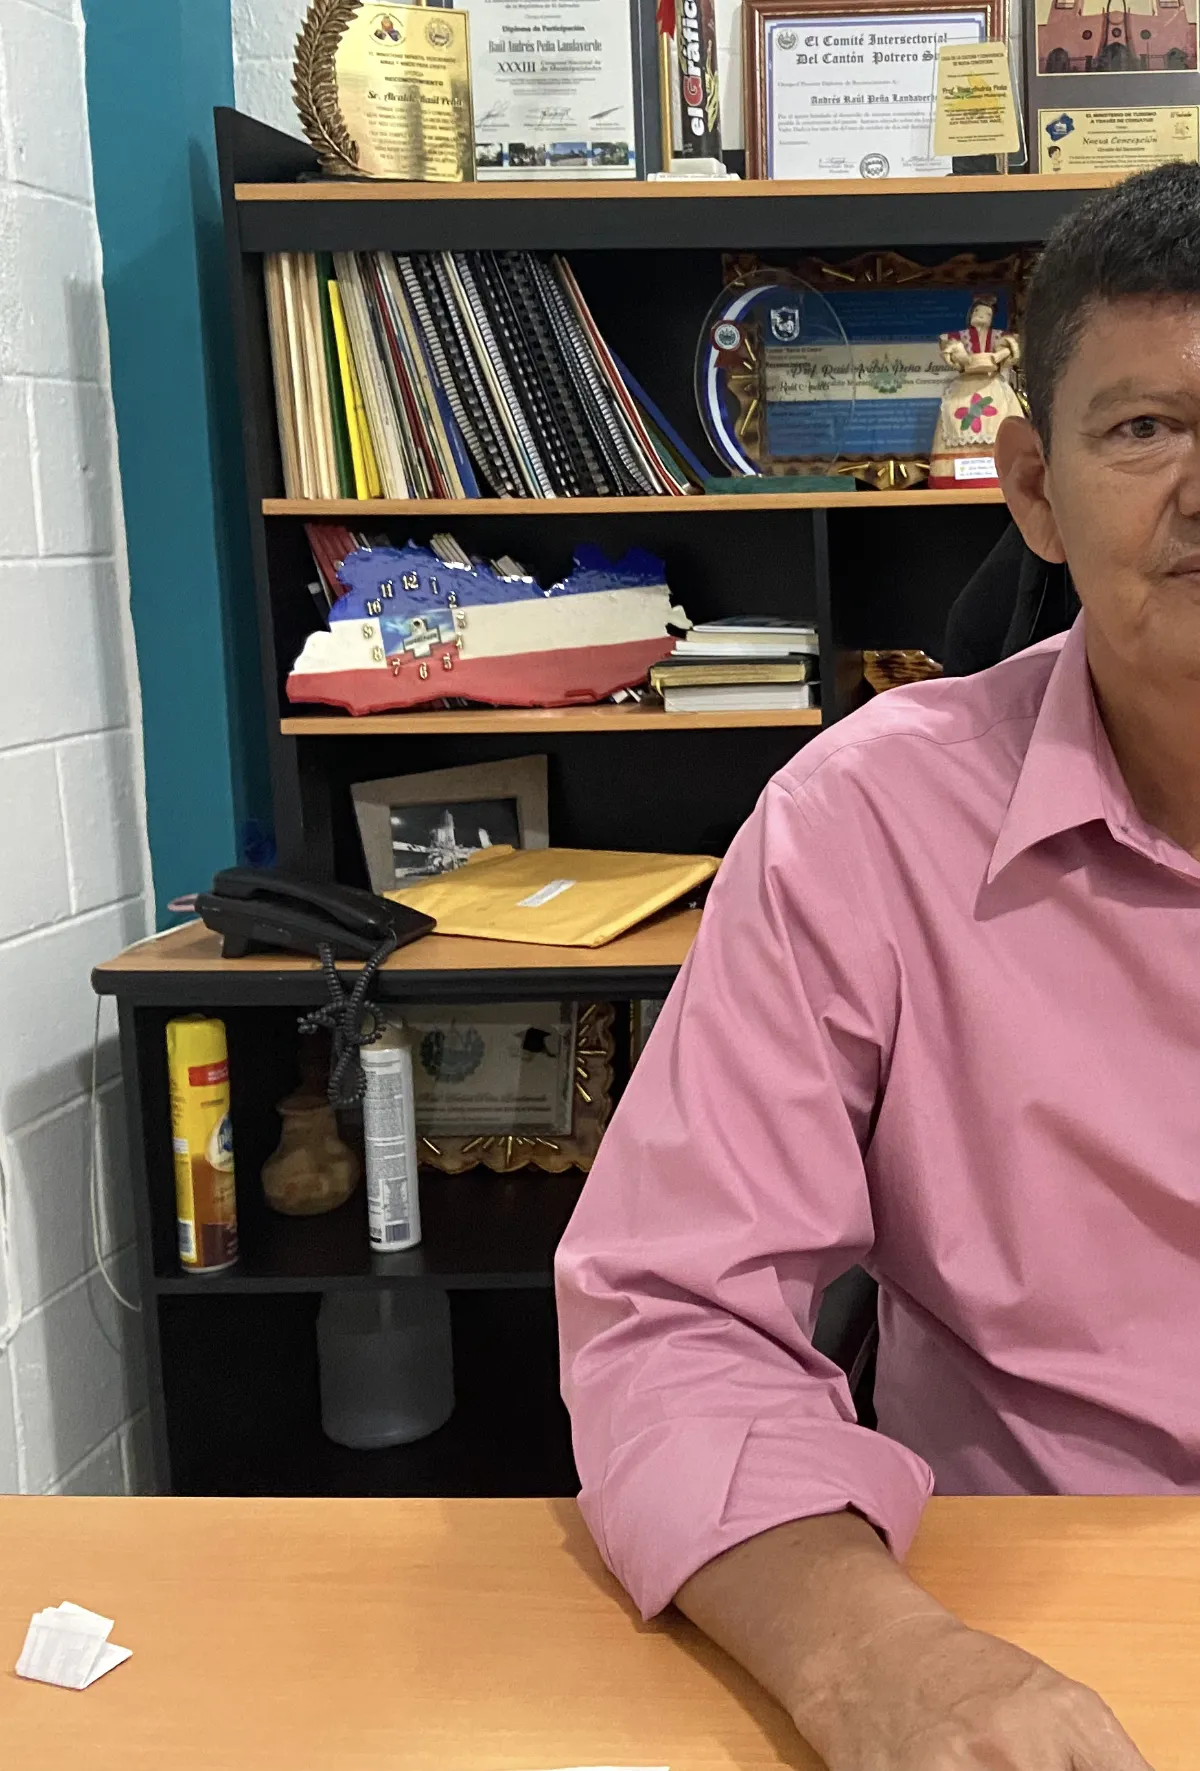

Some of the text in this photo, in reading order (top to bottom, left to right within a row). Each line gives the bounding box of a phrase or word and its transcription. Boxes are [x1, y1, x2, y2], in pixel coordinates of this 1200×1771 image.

[536, 39, 556, 52] Peña
[557, 38, 602, 52] Landaverde
[804, 32, 948, 47] El Comité Intersectorial
[795, 53, 818, 65] Del
[822, 51, 864, 64] Cantón
[871, 51, 918, 65] Potrero
[498, 62, 536, 73] XXXIII
[810, 94, 841, 104] Andrés
[843, 94, 864, 104] Raúl
[867, 94, 890, 104] Peña
[1082, 136, 1158, 145] Nueva Concepción
[381, 580, 393, 598] 11
[402, 571, 419, 590] 12
[430, 576, 438, 594] 1
[367, 598, 382, 616] 10
[448, 591, 458, 609] 2
[391, 658, 401, 676] 7
[419, 662, 428, 679] 6
